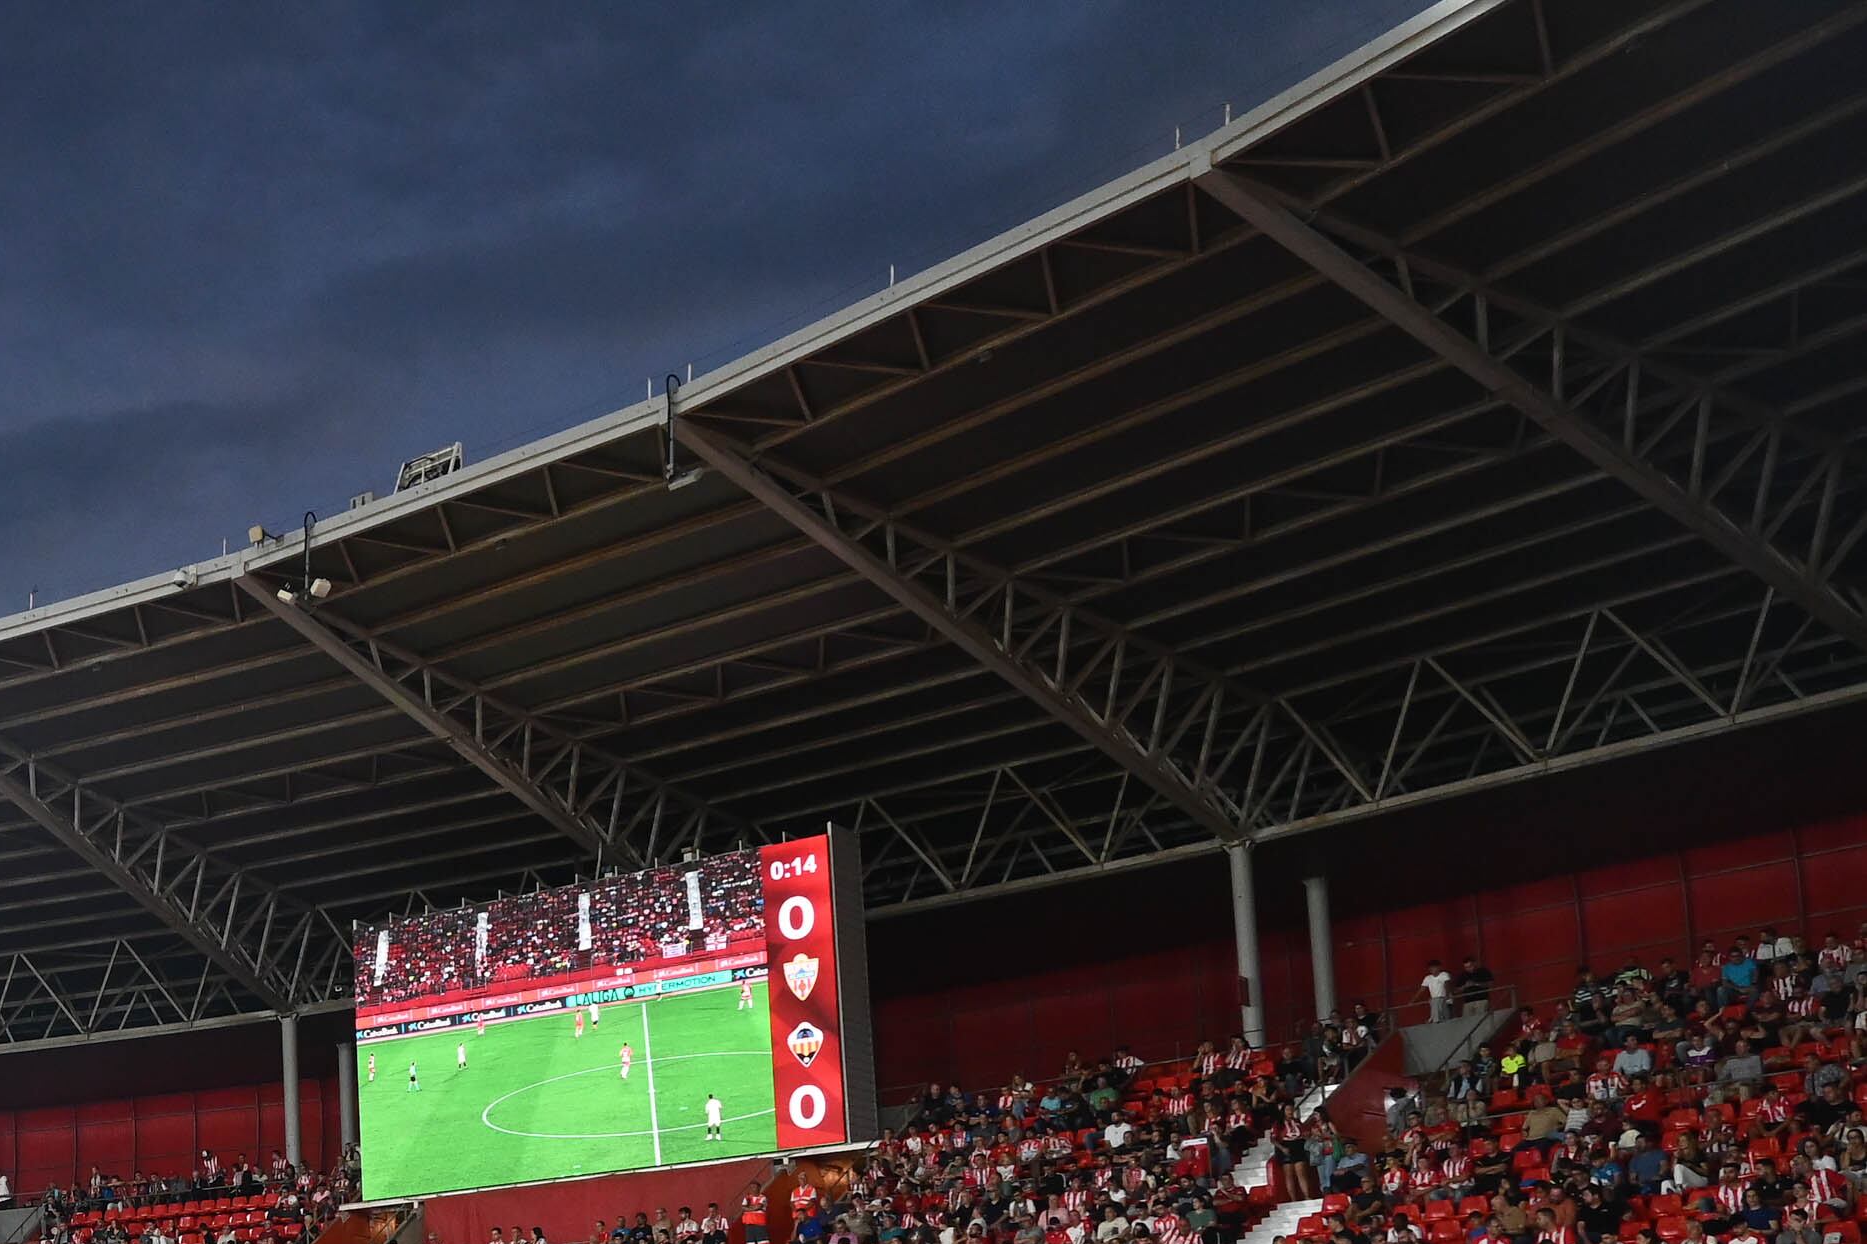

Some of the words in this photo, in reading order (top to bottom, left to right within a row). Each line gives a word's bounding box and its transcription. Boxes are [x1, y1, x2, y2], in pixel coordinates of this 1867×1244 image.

[770, 854, 817, 880] 0:14
[778, 895, 814, 940] 0
[576, 988, 620, 1006] LALIGA
[789, 1084, 826, 1129] 0
